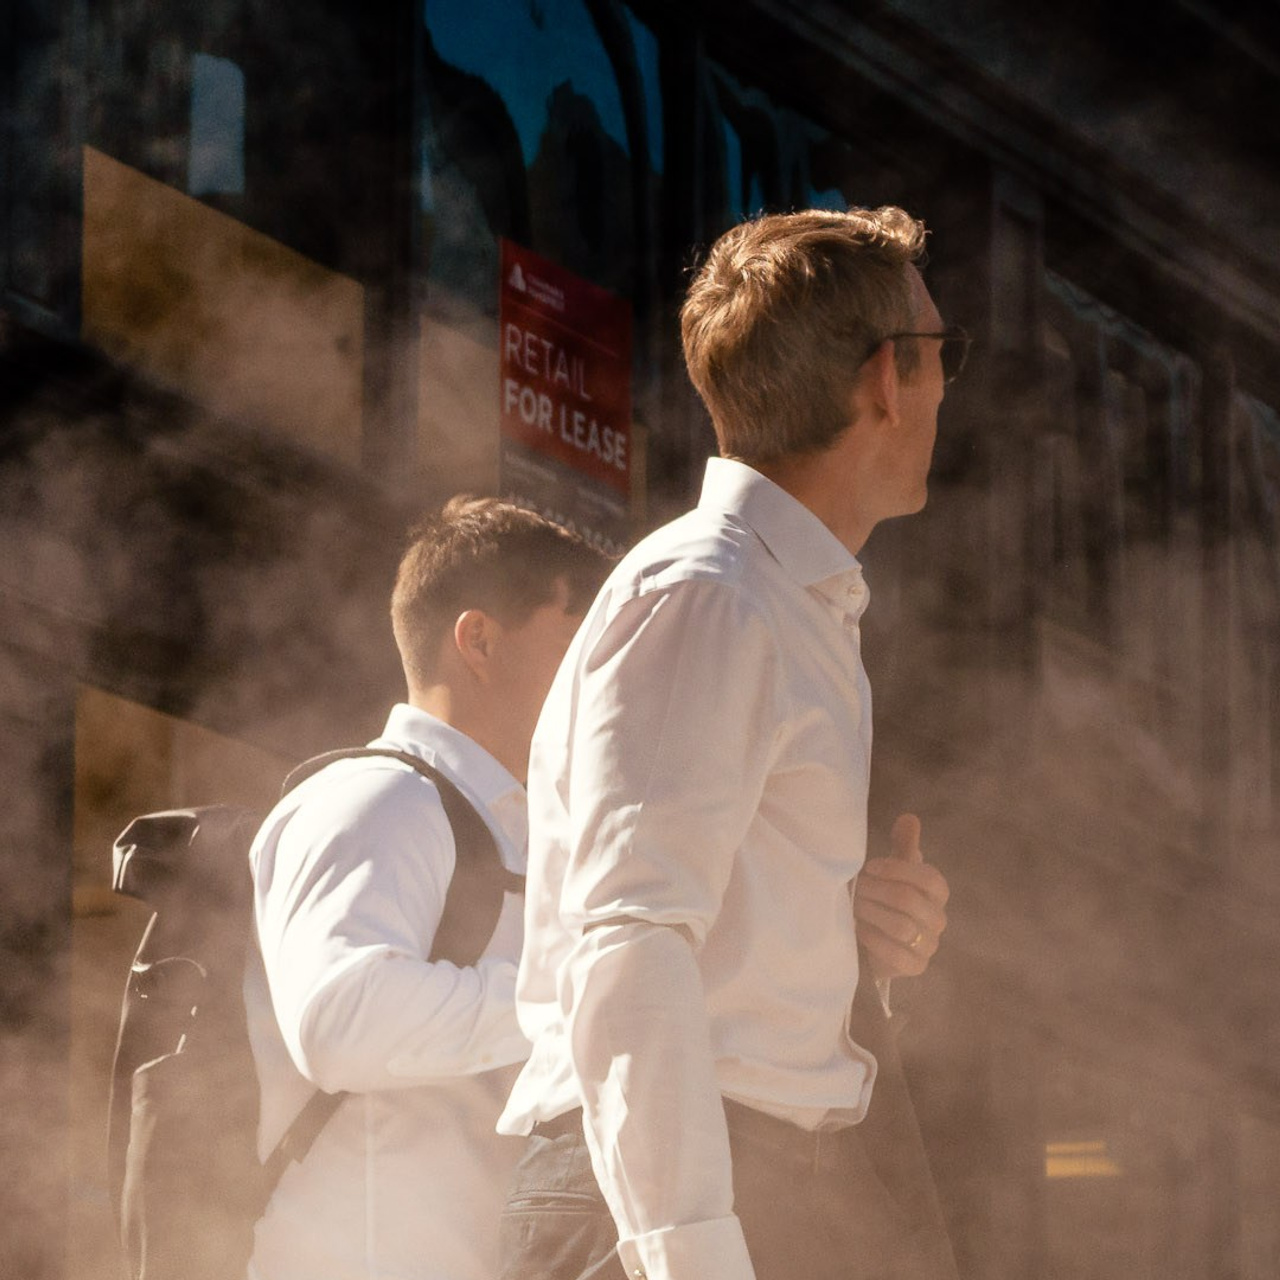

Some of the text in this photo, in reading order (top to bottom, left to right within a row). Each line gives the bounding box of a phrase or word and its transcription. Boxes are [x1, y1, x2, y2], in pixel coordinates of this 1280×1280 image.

[505, 323, 592, 401] RETAIL
[505, 378, 553, 434] FOR
[560, 403, 626, 470] LEASE
